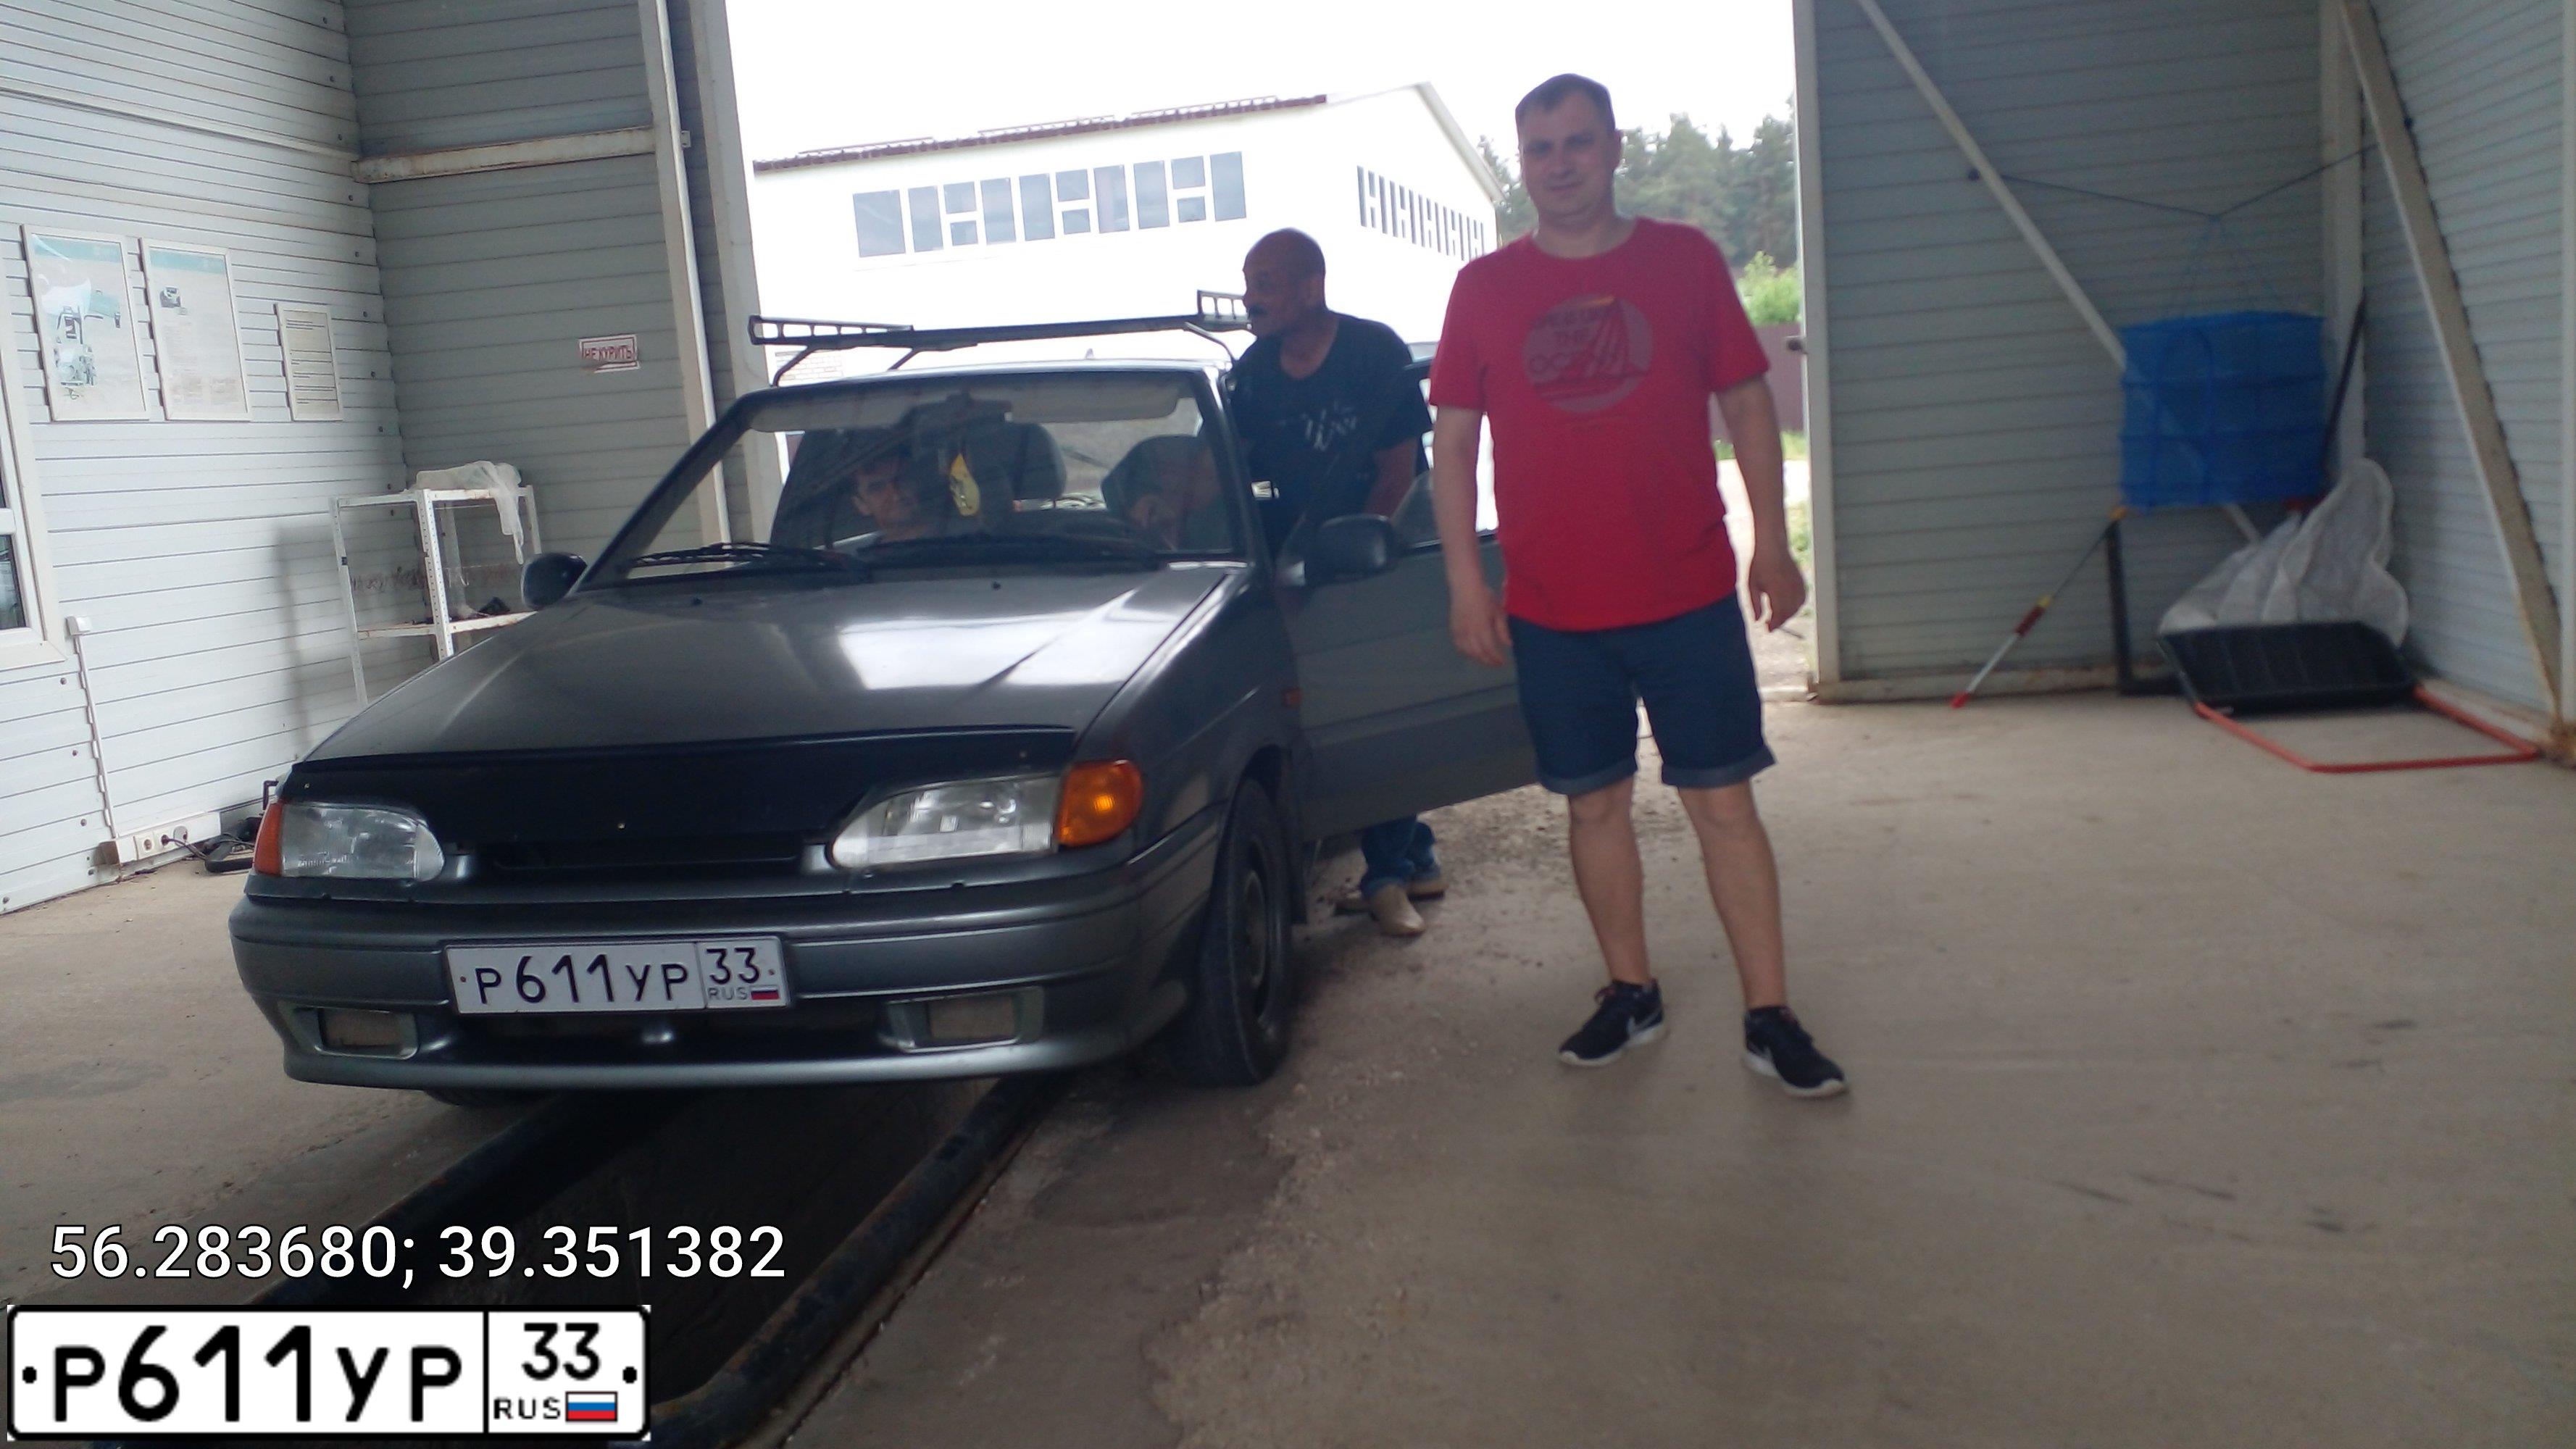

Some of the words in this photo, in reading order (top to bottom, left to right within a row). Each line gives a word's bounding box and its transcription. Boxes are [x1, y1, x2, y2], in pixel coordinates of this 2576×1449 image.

[475, 953, 688, 1004] Р611УР
[706, 947, 760, 984] 33
[707, 987, 748, 1001] RUS
